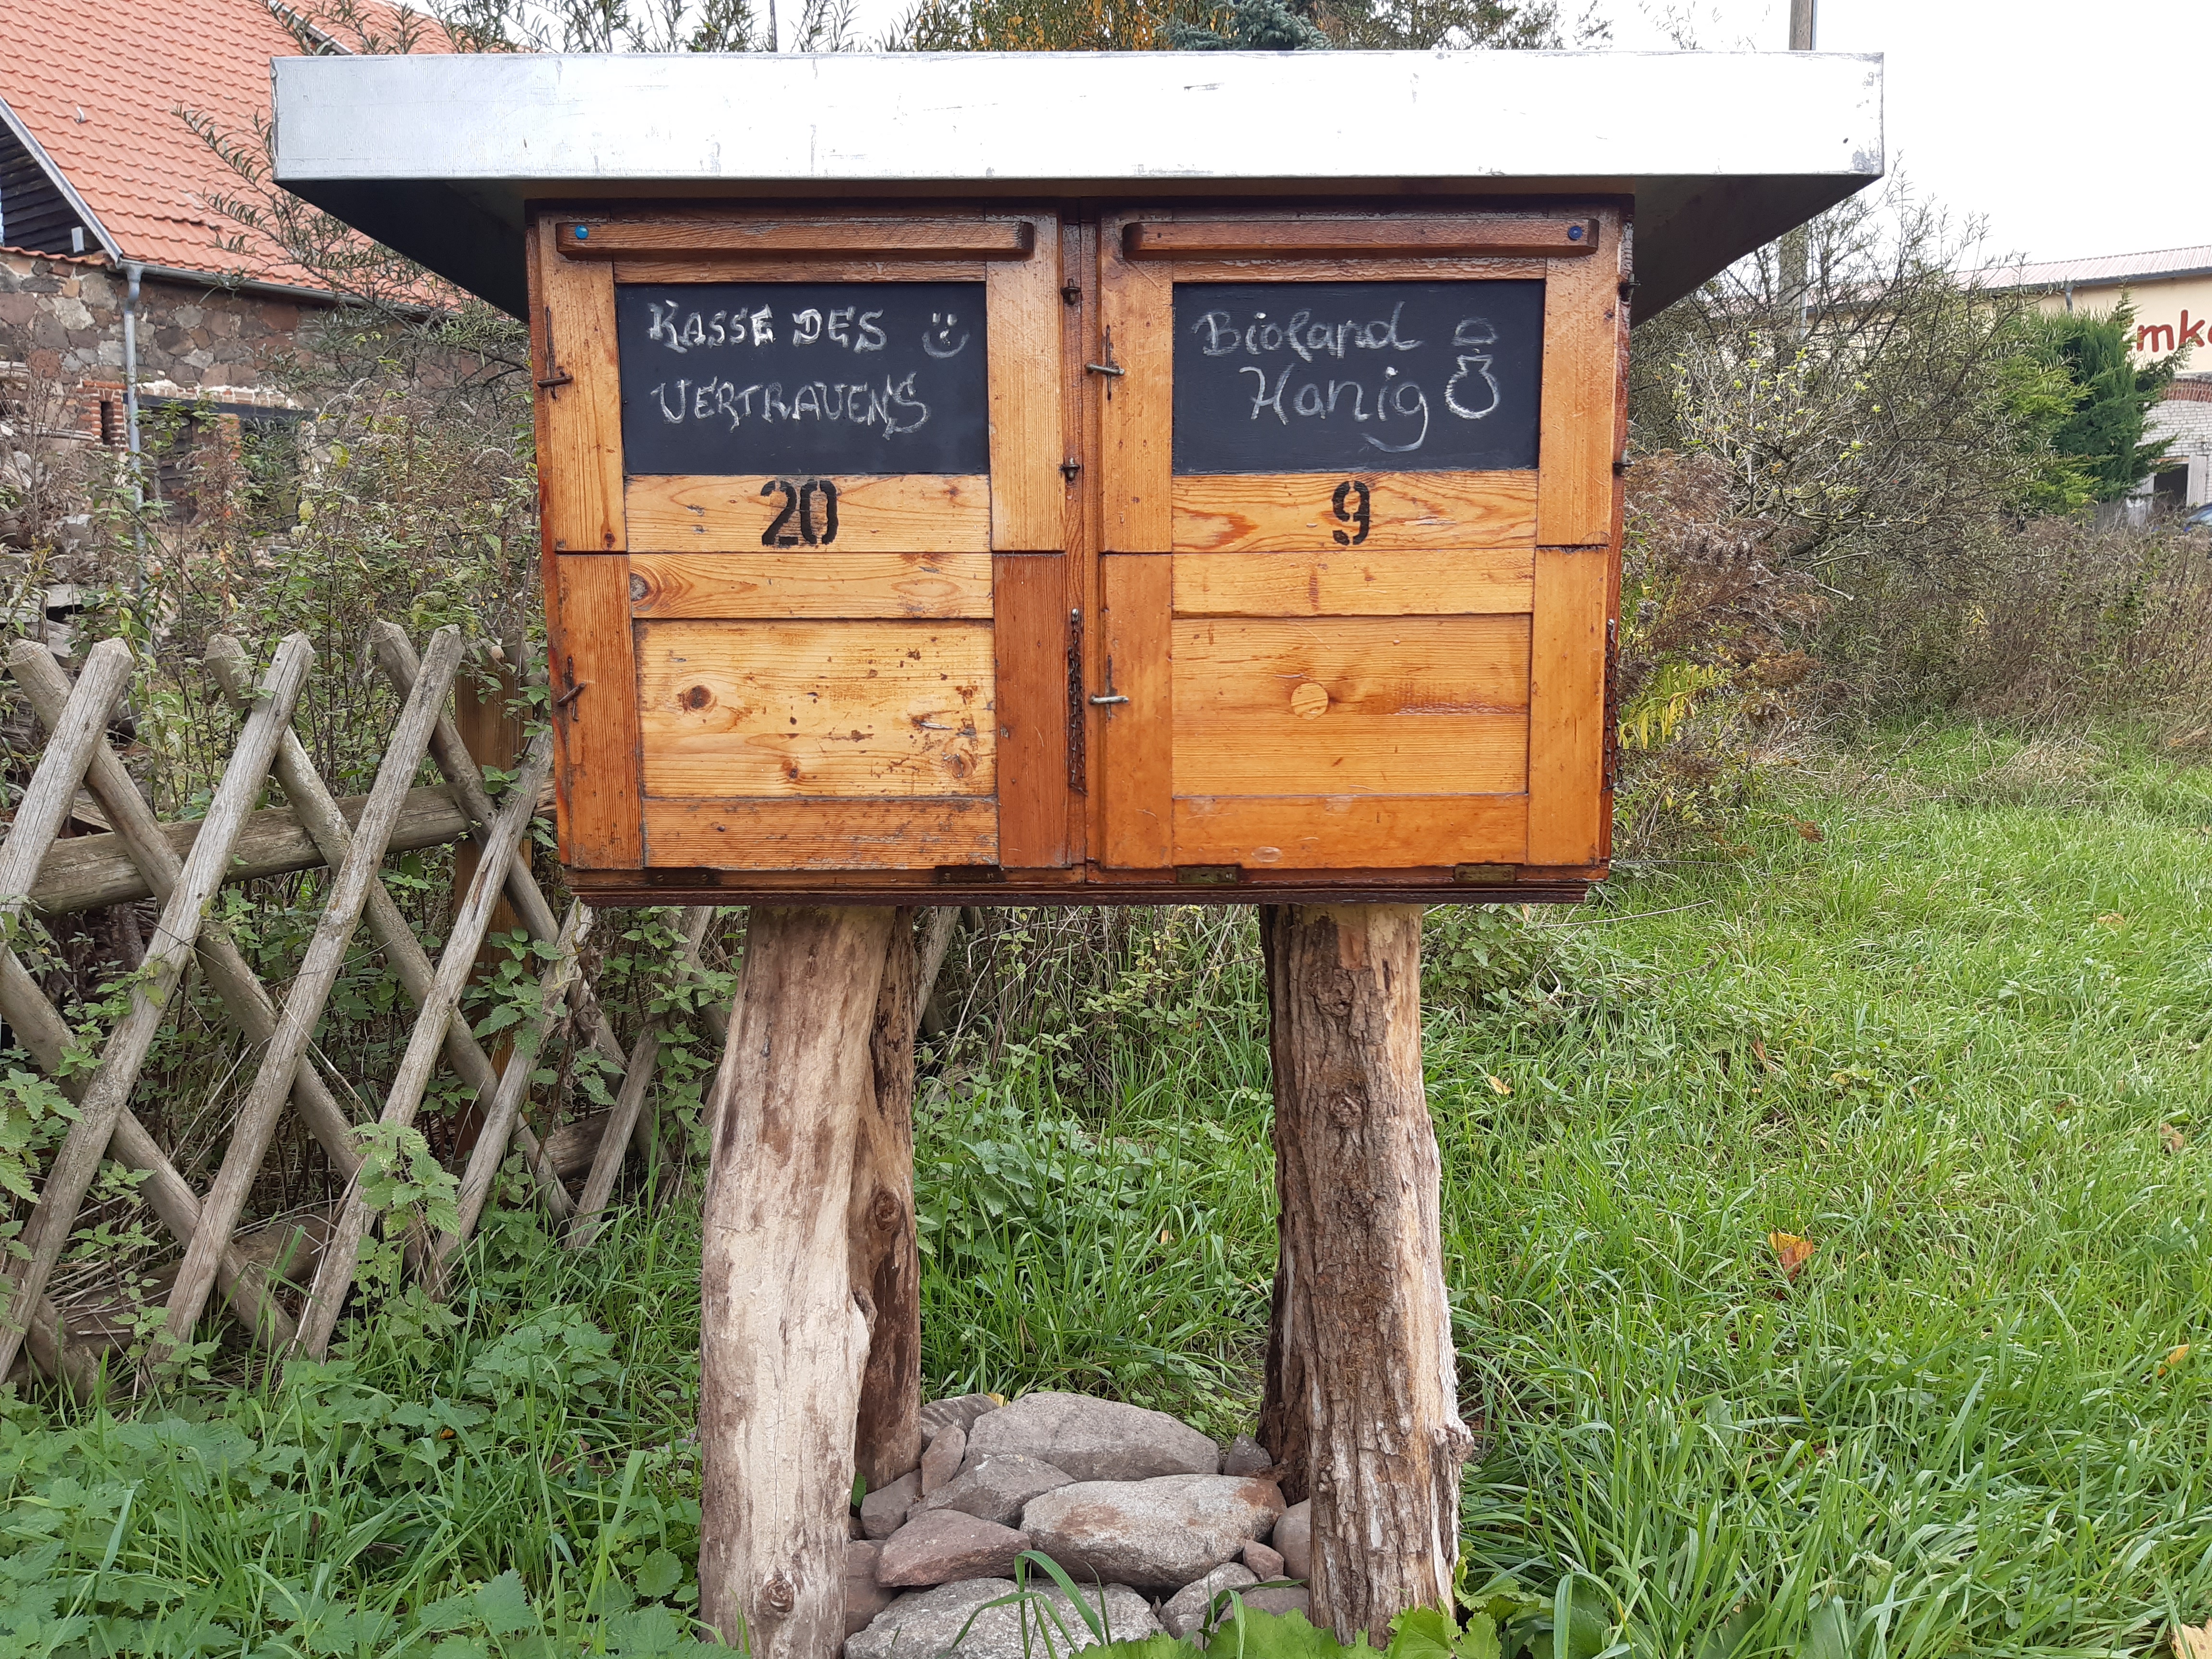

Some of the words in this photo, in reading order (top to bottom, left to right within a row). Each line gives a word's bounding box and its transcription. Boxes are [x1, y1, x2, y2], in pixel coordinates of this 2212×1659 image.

[647, 299, 776, 353] KASSE
[793, 305, 888, 353] DES
[760, 479, 839, 546] 20
[1332, 480, 1370, 546] 9
